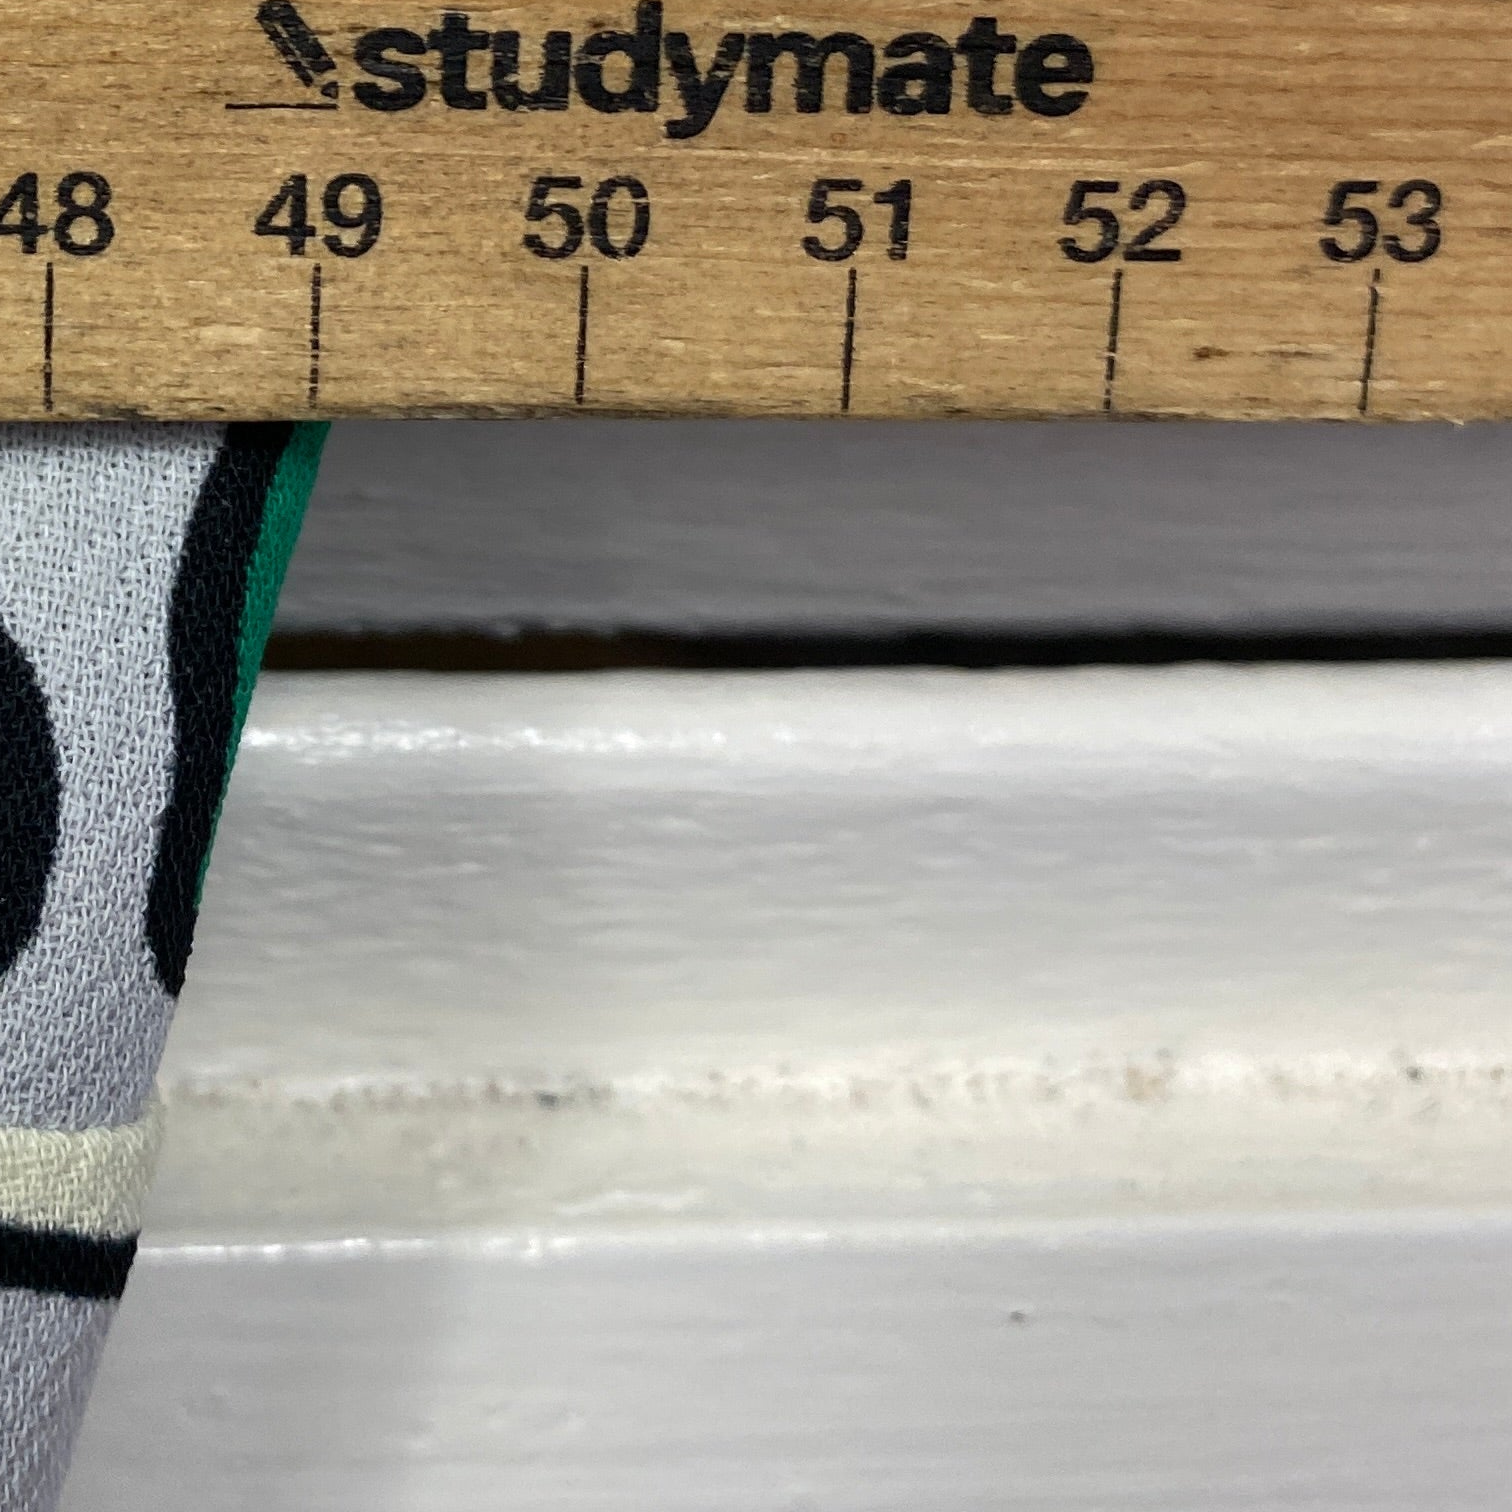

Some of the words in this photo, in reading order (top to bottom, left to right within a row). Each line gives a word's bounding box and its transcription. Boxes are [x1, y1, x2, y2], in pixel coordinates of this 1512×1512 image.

[352, 0, 1095, 140] studymate
[253, 173, 383, 258] 49
[521, 175, 651, 260] 50
[801, 178, 912, 261] 51
[1057, 179, 1187, 263] 52
[1318, 179, 1442, 263] 53
